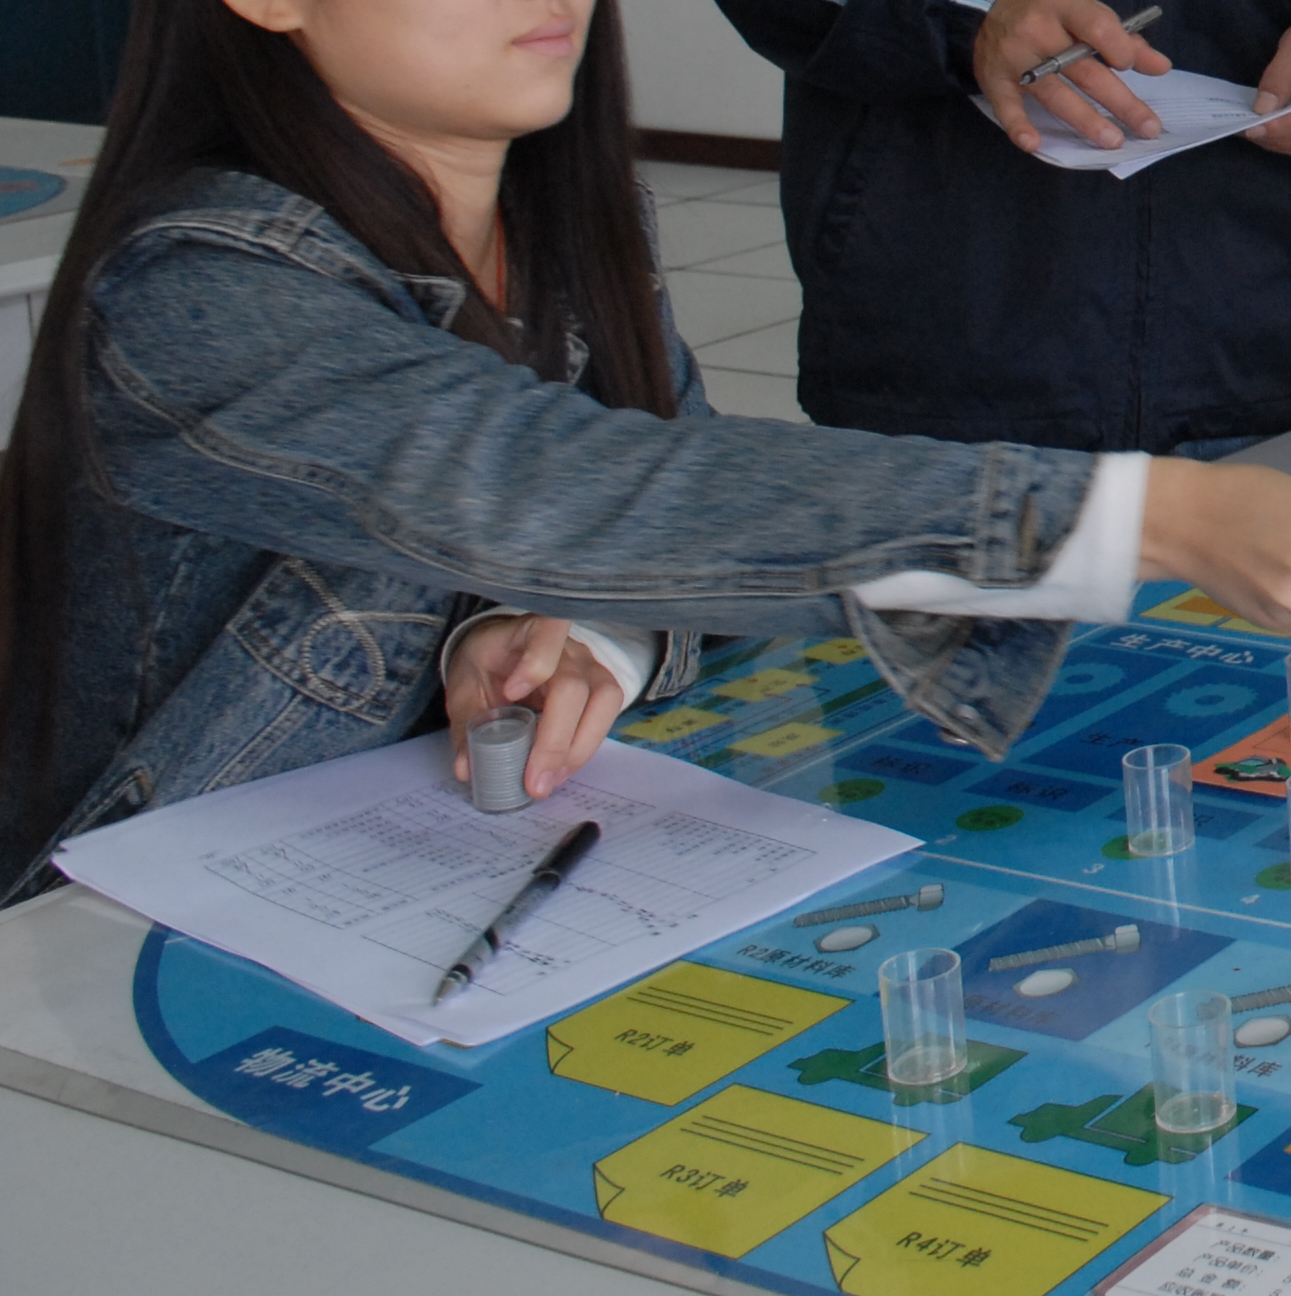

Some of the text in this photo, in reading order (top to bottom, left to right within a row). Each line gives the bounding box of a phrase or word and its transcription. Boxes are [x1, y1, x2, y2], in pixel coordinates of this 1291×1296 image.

[1110, 633, 1254, 665] 生产中心
[738, 944, 857, 979] R2原材料库
[614, 1028, 697, 1057] R2订单
[234, 1047, 412, 1112] 物流中心
[659, 1164, 750, 1198] R3订单
[895, 1231, 993, 1268] R4订单
